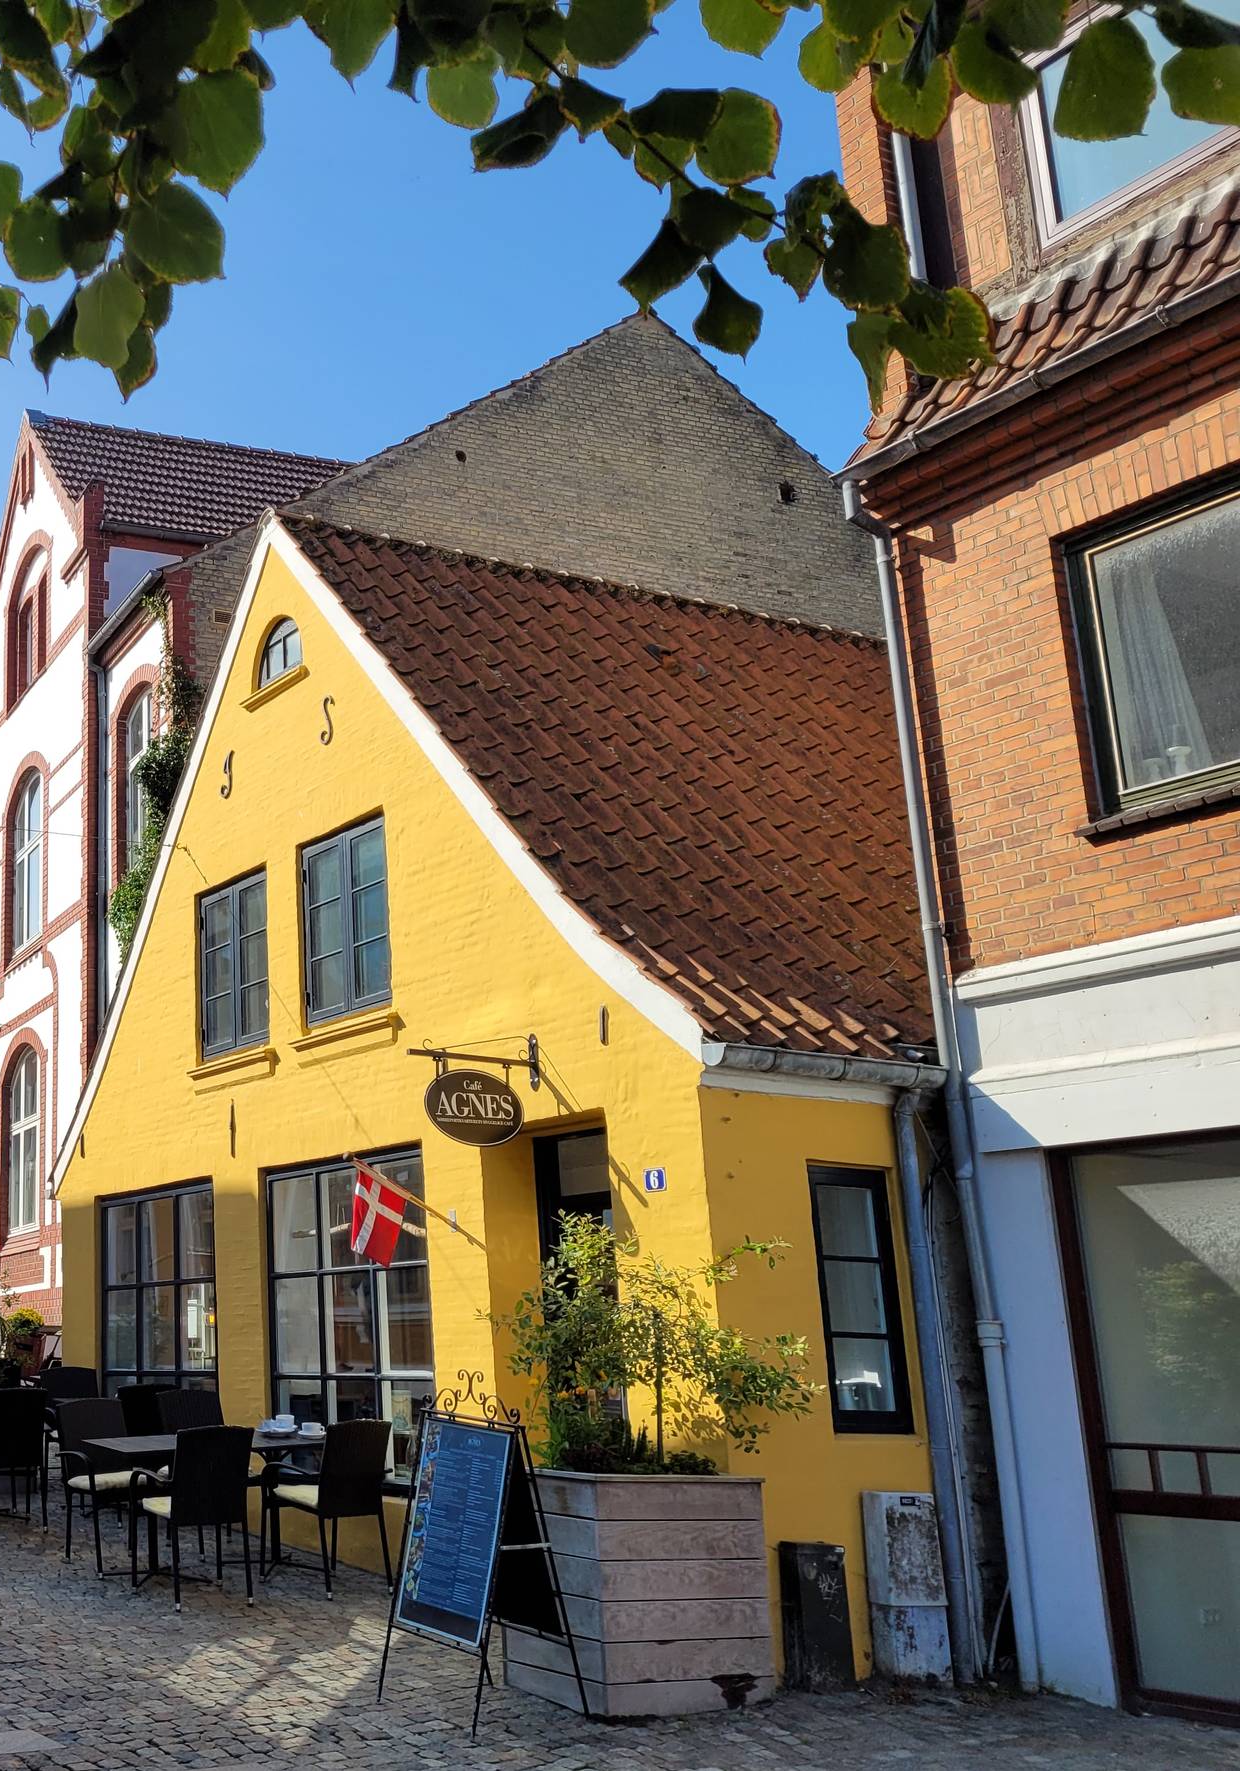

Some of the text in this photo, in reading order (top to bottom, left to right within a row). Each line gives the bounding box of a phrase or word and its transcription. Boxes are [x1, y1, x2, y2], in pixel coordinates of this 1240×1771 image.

[463, 1079, 483, 1091] Café
[435, 1091, 514, 1120] AGNES
[649, 1171, 659, 1189] 6
